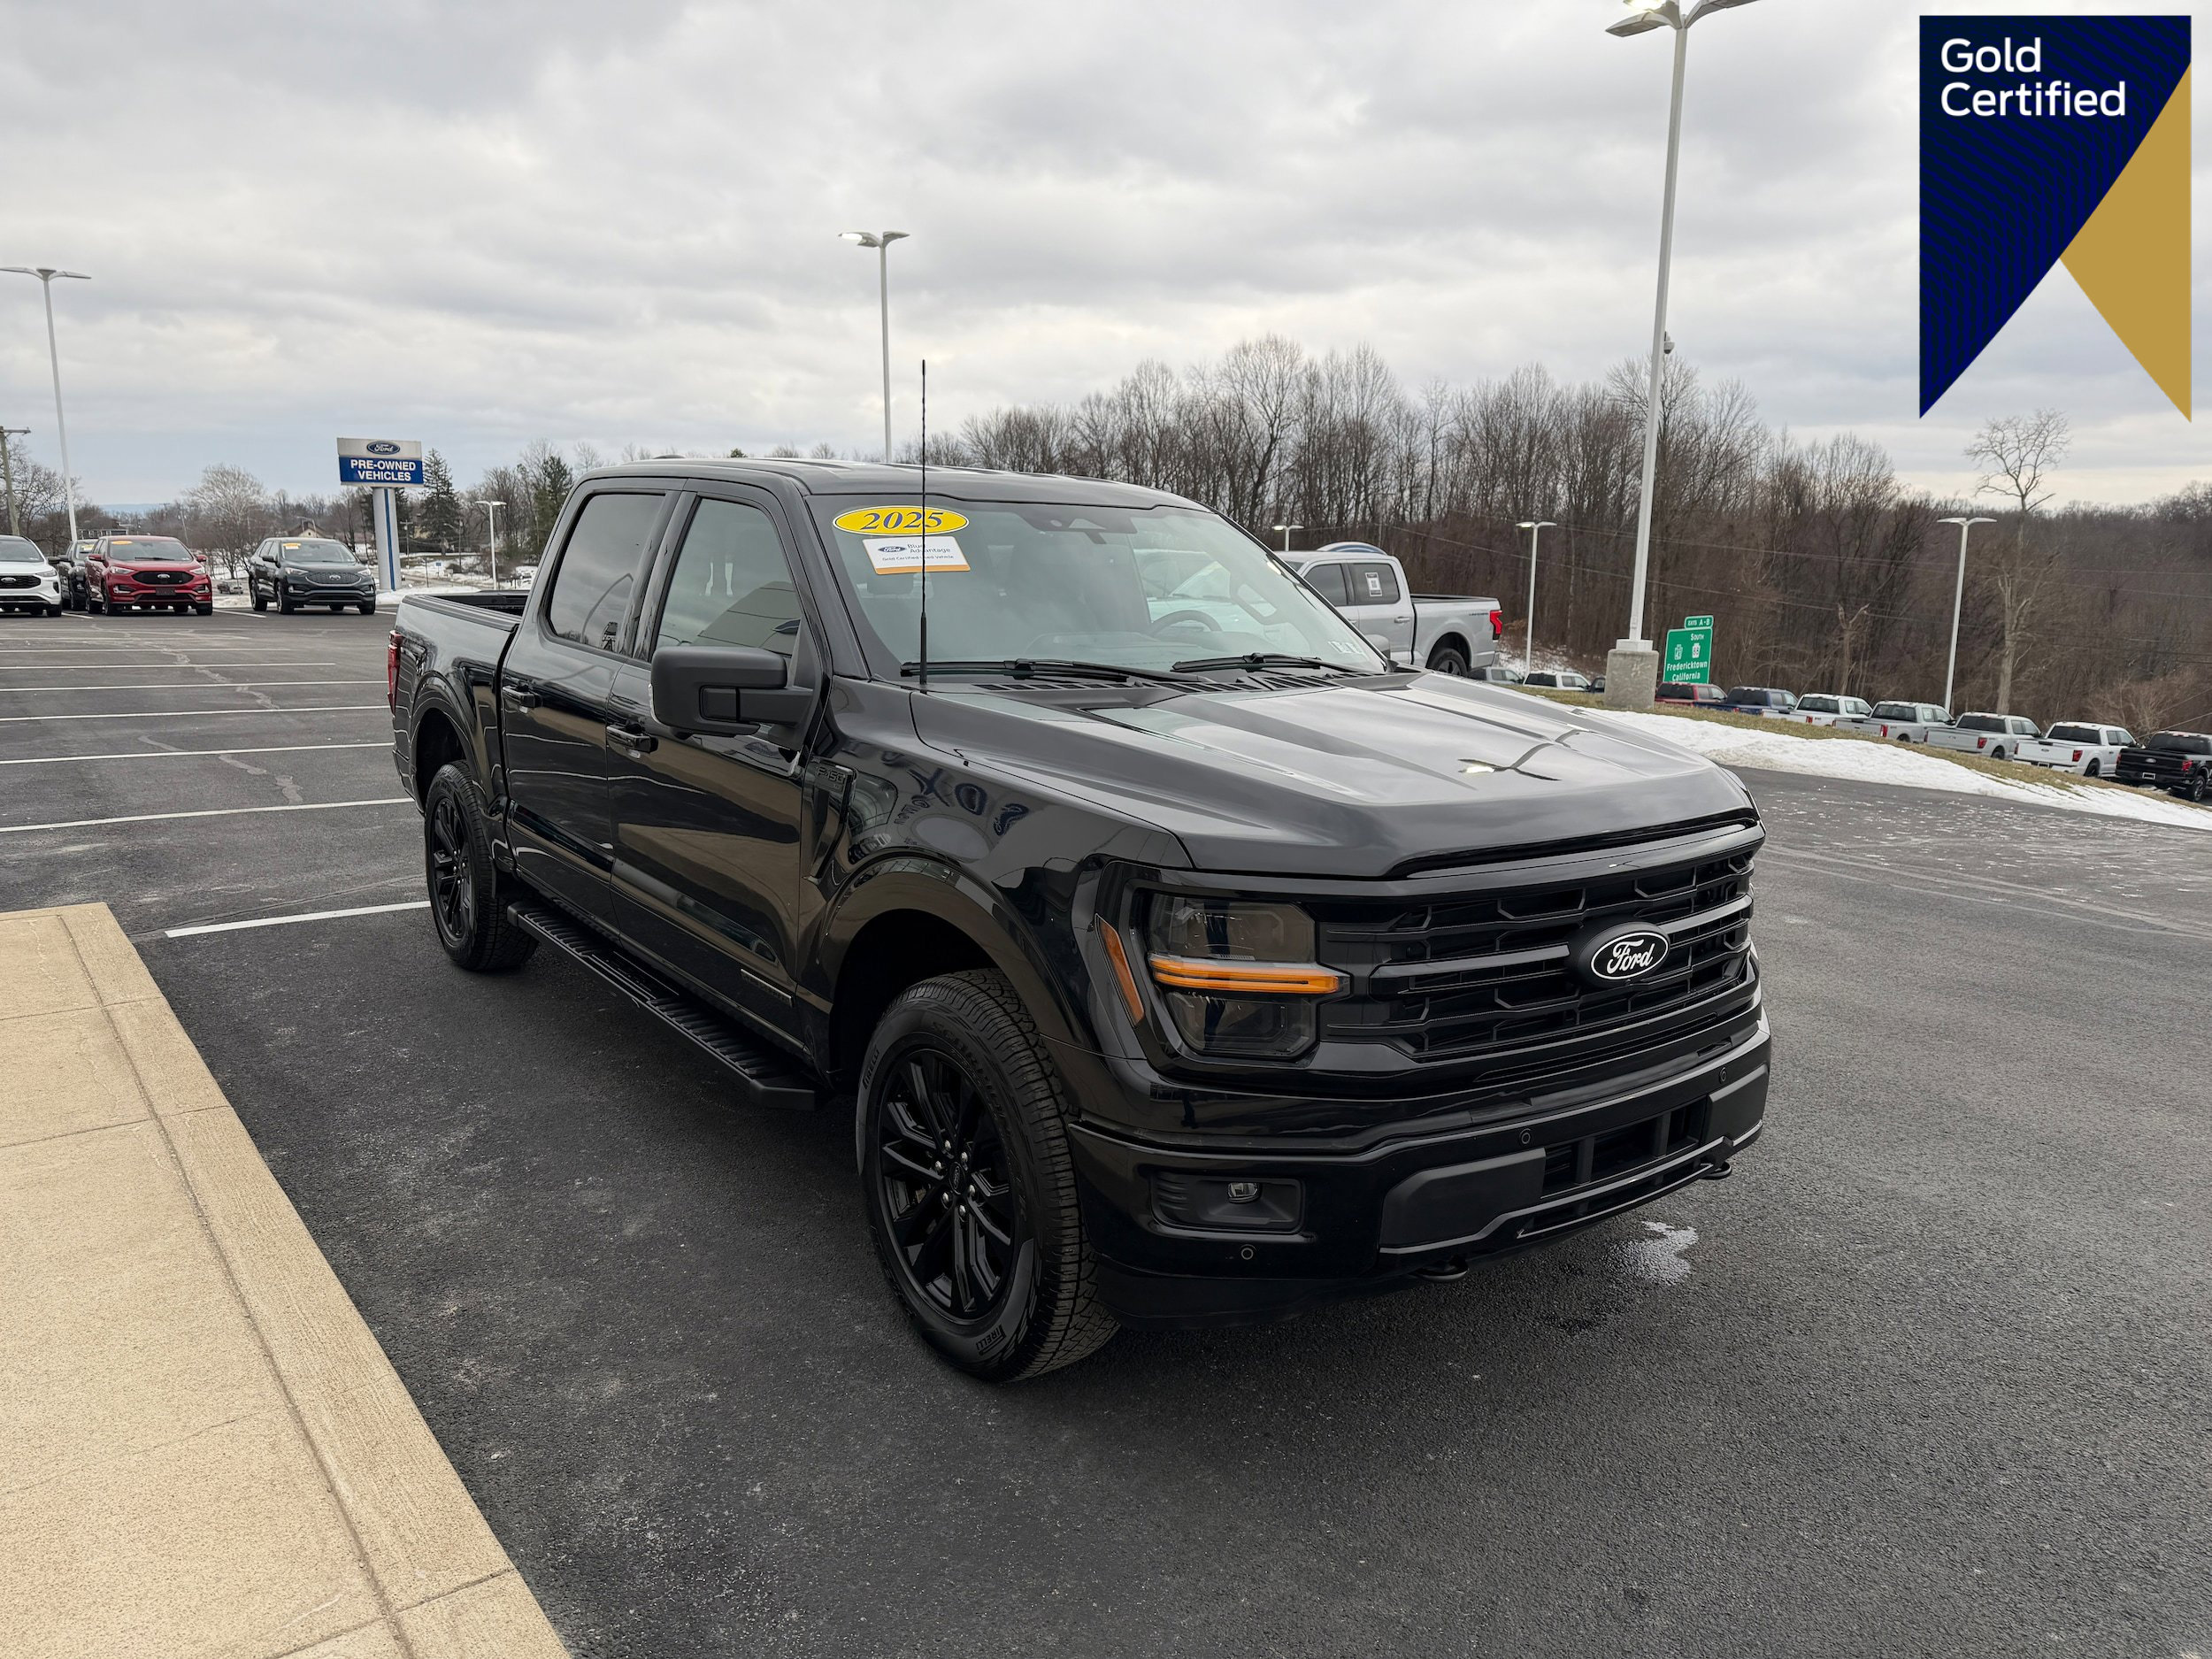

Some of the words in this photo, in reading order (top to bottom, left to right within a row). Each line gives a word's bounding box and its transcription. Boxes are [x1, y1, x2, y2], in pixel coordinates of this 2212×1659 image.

[373, 443, 394, 452] Ford
[350, 459, 416, 471] PRE-OWNED
[357, 471, 411, 481] VEHICLES
[860, 511, 944, 530] 2025
[1667, 661, 1708, 671] Fredericktown
[1672, 672, 1701, 681] California
[1606, 939, 1655, 974] Ford
[976, 1325, 1006, 1355] PIRELLI
